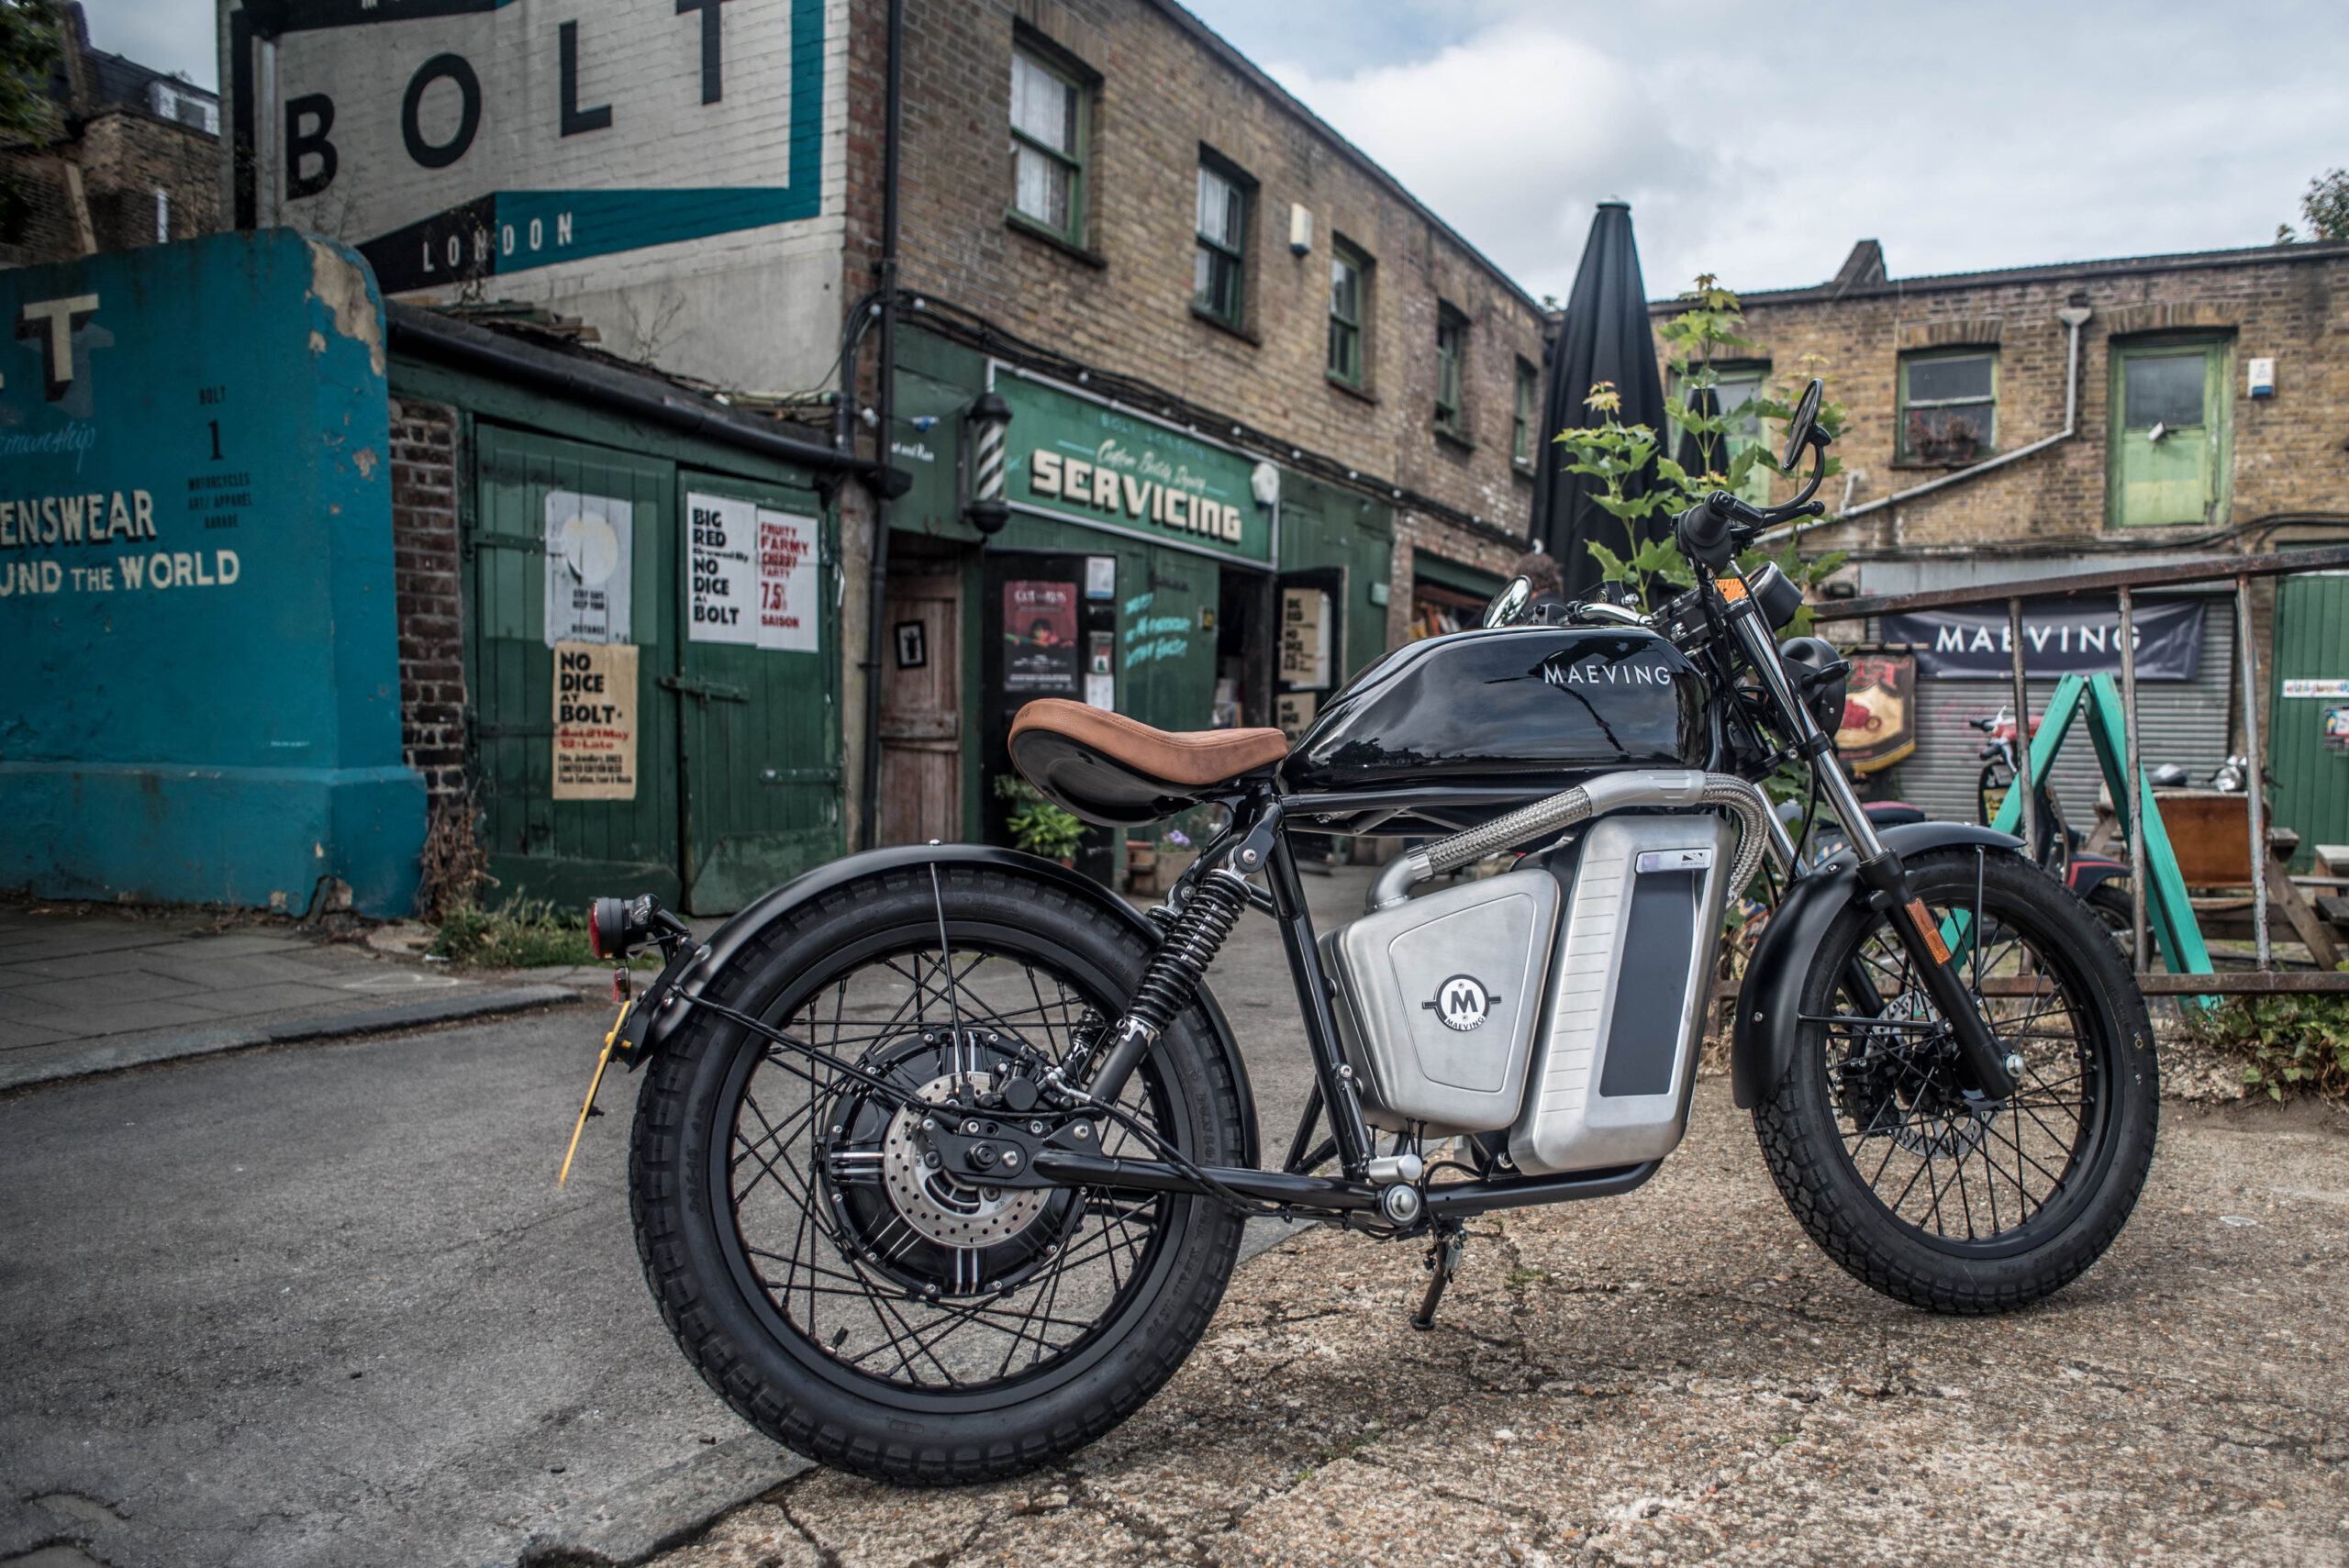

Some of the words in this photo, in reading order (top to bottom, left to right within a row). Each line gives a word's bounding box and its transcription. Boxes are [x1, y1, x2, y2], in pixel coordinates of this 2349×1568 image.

[284, 0, 737, 200] BOLT
[422, 212, 573, 272] LONDON
[198, 385, 226, 406] BOLT
[0, 419, 96, 473] manship
[207, 419, 224, 462] 1
[188, 471, 250, 492] MOTORCYCLES
[1031, 448, 1241, 543] SERVICING
[693, 507, 722, 528] BIG
[693, 528, 726, 548] RED
[761, 521, 797, 538] FRUITY
[761, 536, 808, 557] FARMY
[70, 567, 114, 592] THE
[118, 550, 240, 589] WORLD
[693, 557, 718, 575] NO
[694, 576, 729, 595] DICE
[694, 605, 740, 626] BOLT
[761, 614, 800, 628] SAISON
[1935, 625, 2142, 653] MAEVING
[561, 651, 591, 671] NO
[561, 673, 604, 693] DICE
[1543, 663, 1671, 685] MAEVING
[561, 693, 579, 703] AT
[561, 704, 616, 724] BOLT
[1451, 989, 1478, 1015] M
[1446, 1016, 1484, 1030] MAEVING
